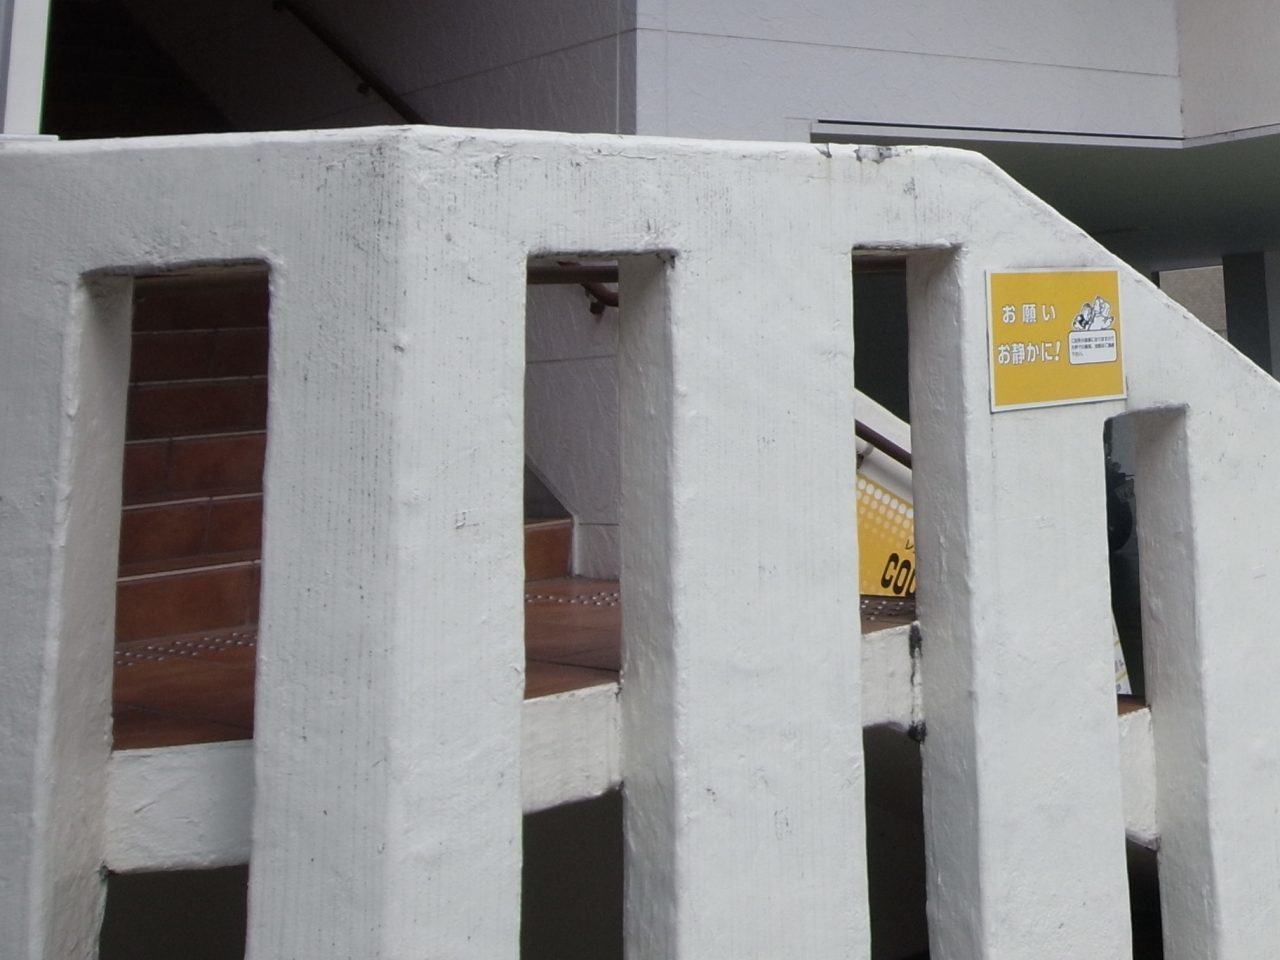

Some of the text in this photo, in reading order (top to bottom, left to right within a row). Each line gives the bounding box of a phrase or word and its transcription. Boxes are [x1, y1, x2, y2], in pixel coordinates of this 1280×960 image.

[1002, 304, 1056, 324] お願い
[998, 342, 1061, 365] お静かに!
